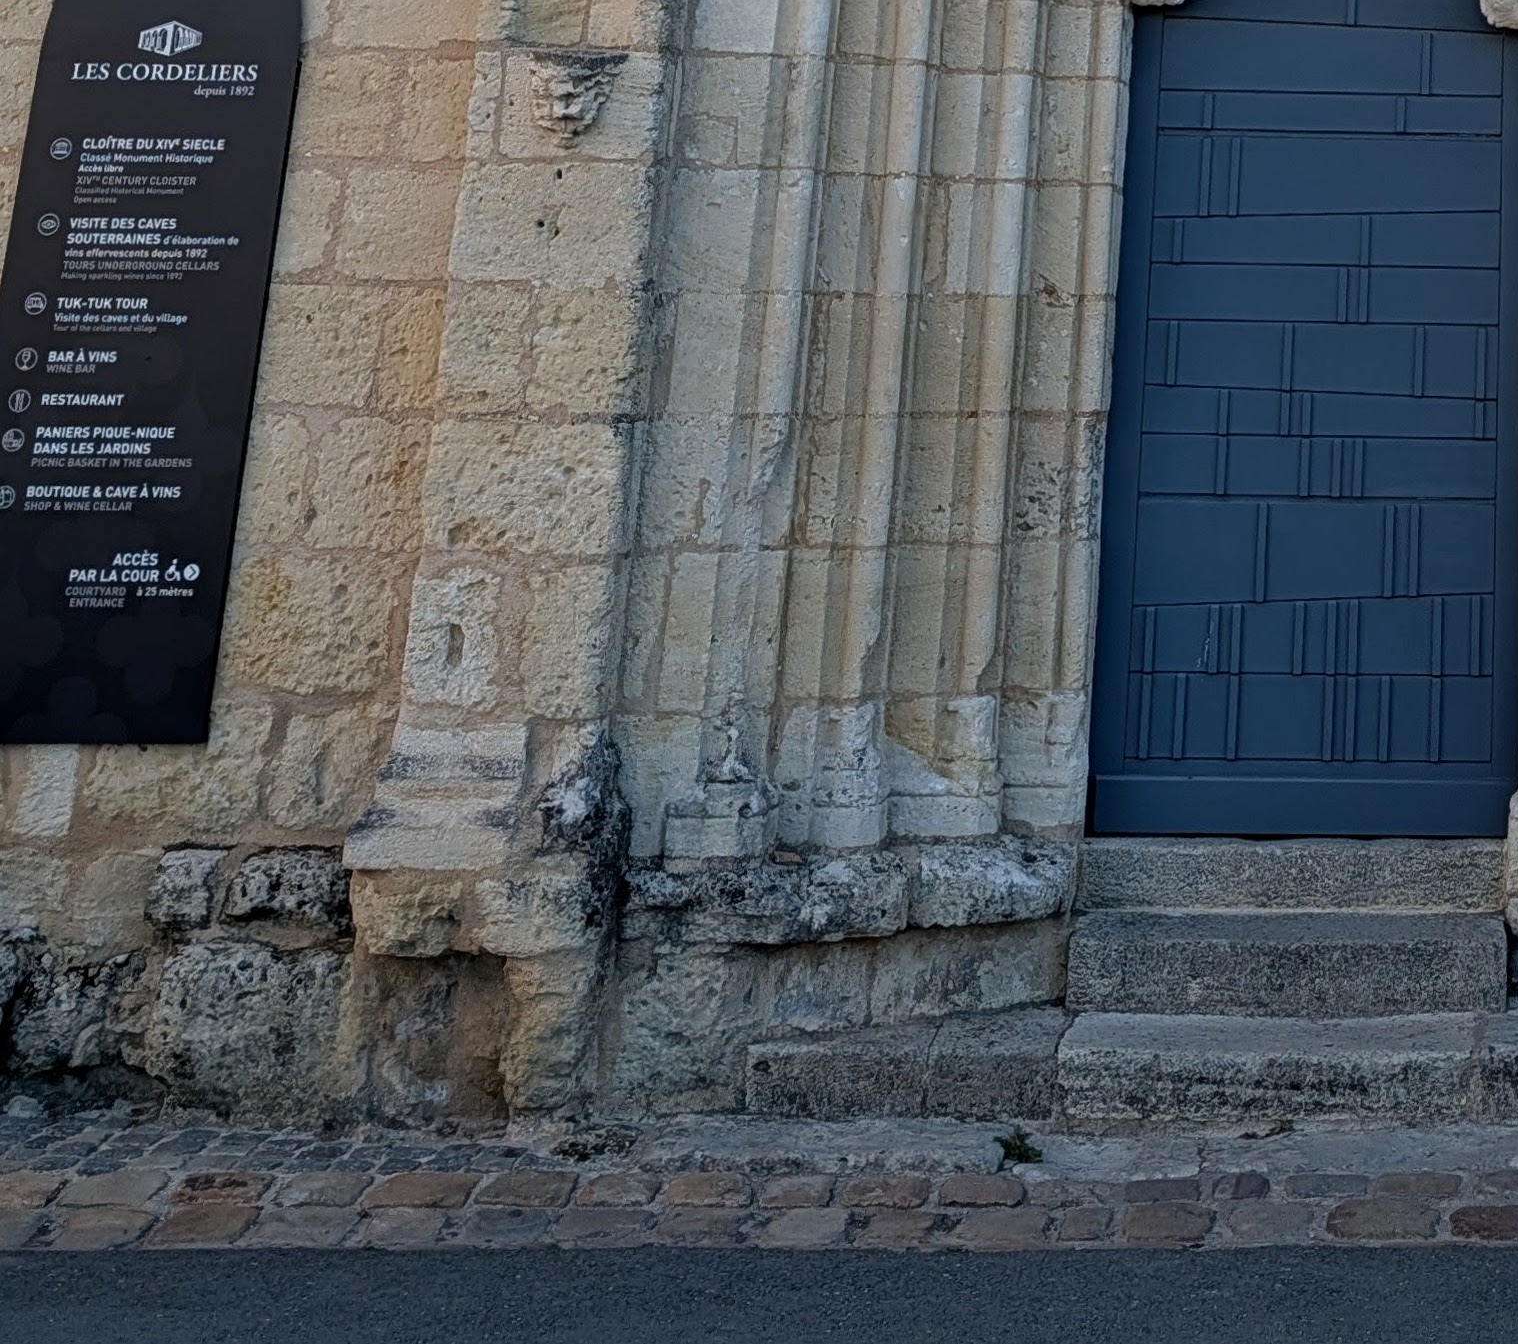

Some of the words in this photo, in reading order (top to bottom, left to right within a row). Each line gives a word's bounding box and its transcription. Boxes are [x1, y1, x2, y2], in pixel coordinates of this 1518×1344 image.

[71, 62, 110, 82] LES
[116, 62, 258, 82] CORDELIERS
[194, 85, 226, 98] depuis
[229, 85, 255, 97] 1892
[82, 135, 134, 150] CLOÎTRE
[136, 138, 153, 150] DU
[80, 153, 111, 163] Classé
[113, 153, 163, 163] Monument
[165, 153, 214, 165] Historique
[78, 164, 102, 173] Accès
[104, 164, 124, 173] libre
[102, 176, 147, 186] CENTURY
[149, 176, 197, 186] CLOISTER
[74, 196, 91, 205] Open
[93, 196, 117, 204] access
[70, 218, 108, 230] VISITE
[111, 218, 135, 230] DES
[137, 218, 177, 230] CAVES
[66, 233, 161, 245] SOUTERRAINES
[163, 235, 226, 245] d'élaboration
[227, 236, 239, 246] de
[65, 249, 83, 258] vins
[86, 249, 149, 258] effervescents
[151, 249, 183, 260] depuis
[185, 249, 208, 258] 1892
[62, 261, 95, 270] TOURS
[98, 261, 173, 270] UNDERGROUND
[175, 261, 220, 270] CELLARS
[57, 298, 113, 309] TUK-TUK
[115, 298, 148, 309] TOUR
[54, 313, 80, 323] Visite
[83, 313, 99, 323] des
[102, 313, 128, 323] caves
[130, 313, 140, 323] et
[142, 313, 154, 323] du
[156, 313, 188, 325] village
[48, 351, 73, 362] BAR
[76, 348, 86, 362] À
[88, 351, 117, 362] VINS
[46, 364, 73, 373] WINE
[75, 364, 95, 373] BAR
[41, 394, 124, 406] RESTAURANT
[36, 427, 90, 438] PANIERS
[93, 427, 175, 438] PIQUE-NIQUE
[33, 443, 68, 454] DANS
[70, 443, 94, 454] LES
[97, 443, 151, 454] JARDINS
[30, 458, 65, 467] PICNIC
[67, 458, 107, 467] BASKET
[109, 458, 120, 467] IN
[122, 458, 142, 467] THE
[144, 458, 192, 467] GARDENS
[26, 486, 90, 498] BOUTIQUE
[93, 486, 102, 498] &
[105, 486, 137, 498] CAVE
[139, 483, 148, 498] À
[152, 486, 181, 498] VINS
[24, 502, 51, 511] SHOP
[54, 502, 61, 511] &
[64, 502, 90, 511] WINE
[93, 502, 132, 511] CELLAR
[112, 550, 159, 566] ACCÈS
[69, 570, 96, 582] PAR
[100, 570, 118, 582] LA
[121, 570, 159, 582] COUR
[65, 586, 126, 596] COURTYARD
[136, 587, 143, 596] à
[145, 587, 157, 596] 25
[159, 587, 193, 596] mètres
[69, 598, 125, 607] ENTRANCE
